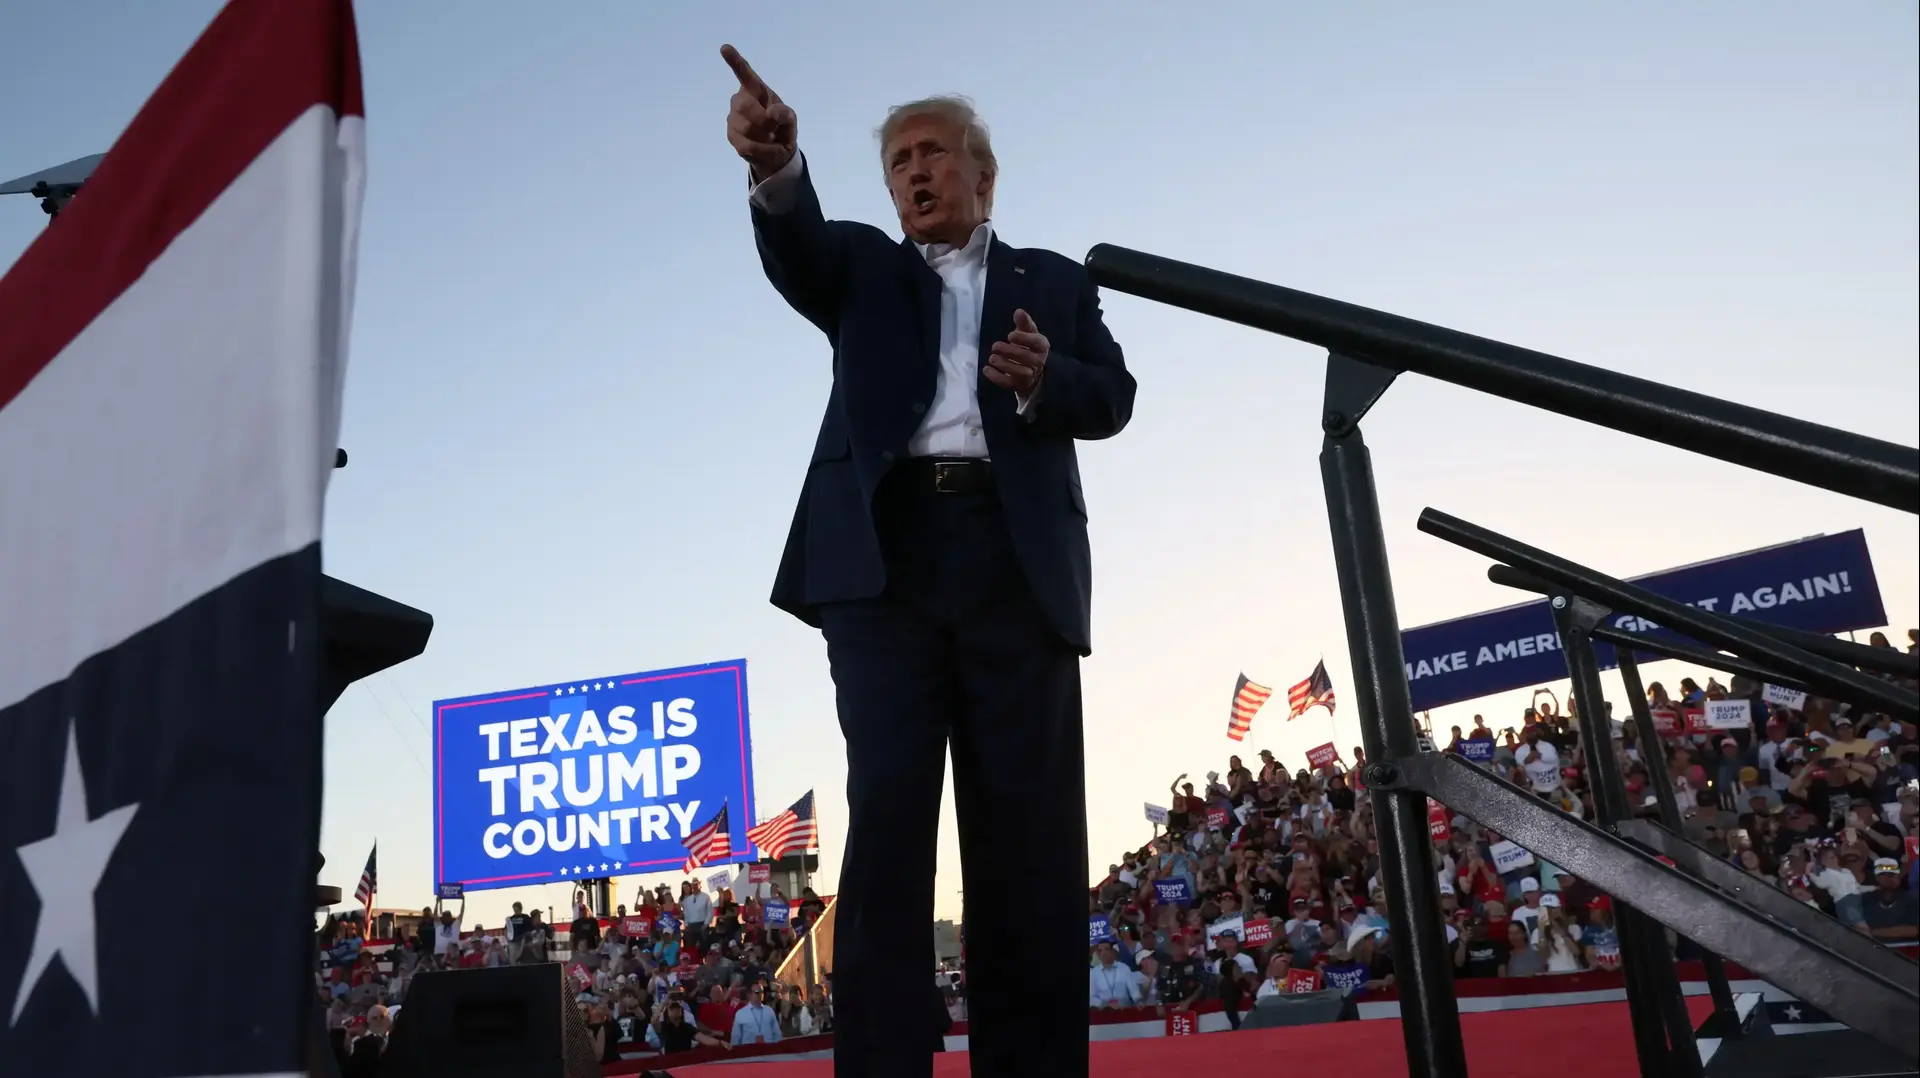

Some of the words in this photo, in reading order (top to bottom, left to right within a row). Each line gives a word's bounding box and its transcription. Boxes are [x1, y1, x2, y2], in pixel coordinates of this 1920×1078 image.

[1614, 598, 1718, 632] GRT
[1730, 571, 1852, 614] AGAIN!
[1770, 691, 1797, 703] HUNT
[1711, 705, 1746, 713] TRUMP
[1716, 712, 1742, 720] 2024
[479, 705, 637, 761] TEXAS
[652, 697, 698, 740] IS
[1460, 742, 1490, 750] TRUMP
[478, 743, 701, 816] TRUMP
[1208, 812, 1224, 820] ITCH
[482, 800, 702, 859] COUNTRY
[1498, 850, 1527, 865] TRUMP
[1156, 884, 1184, 892] TRUMP
[768, 911, 783, 919] 2024
[1245, 924, 1270, 935] WITC
[1247, 931, 1273, 942] HUNT
[1326, 969, 1363, 981] TRUMP
[1173, 1015, 1181, 1036] TCH
